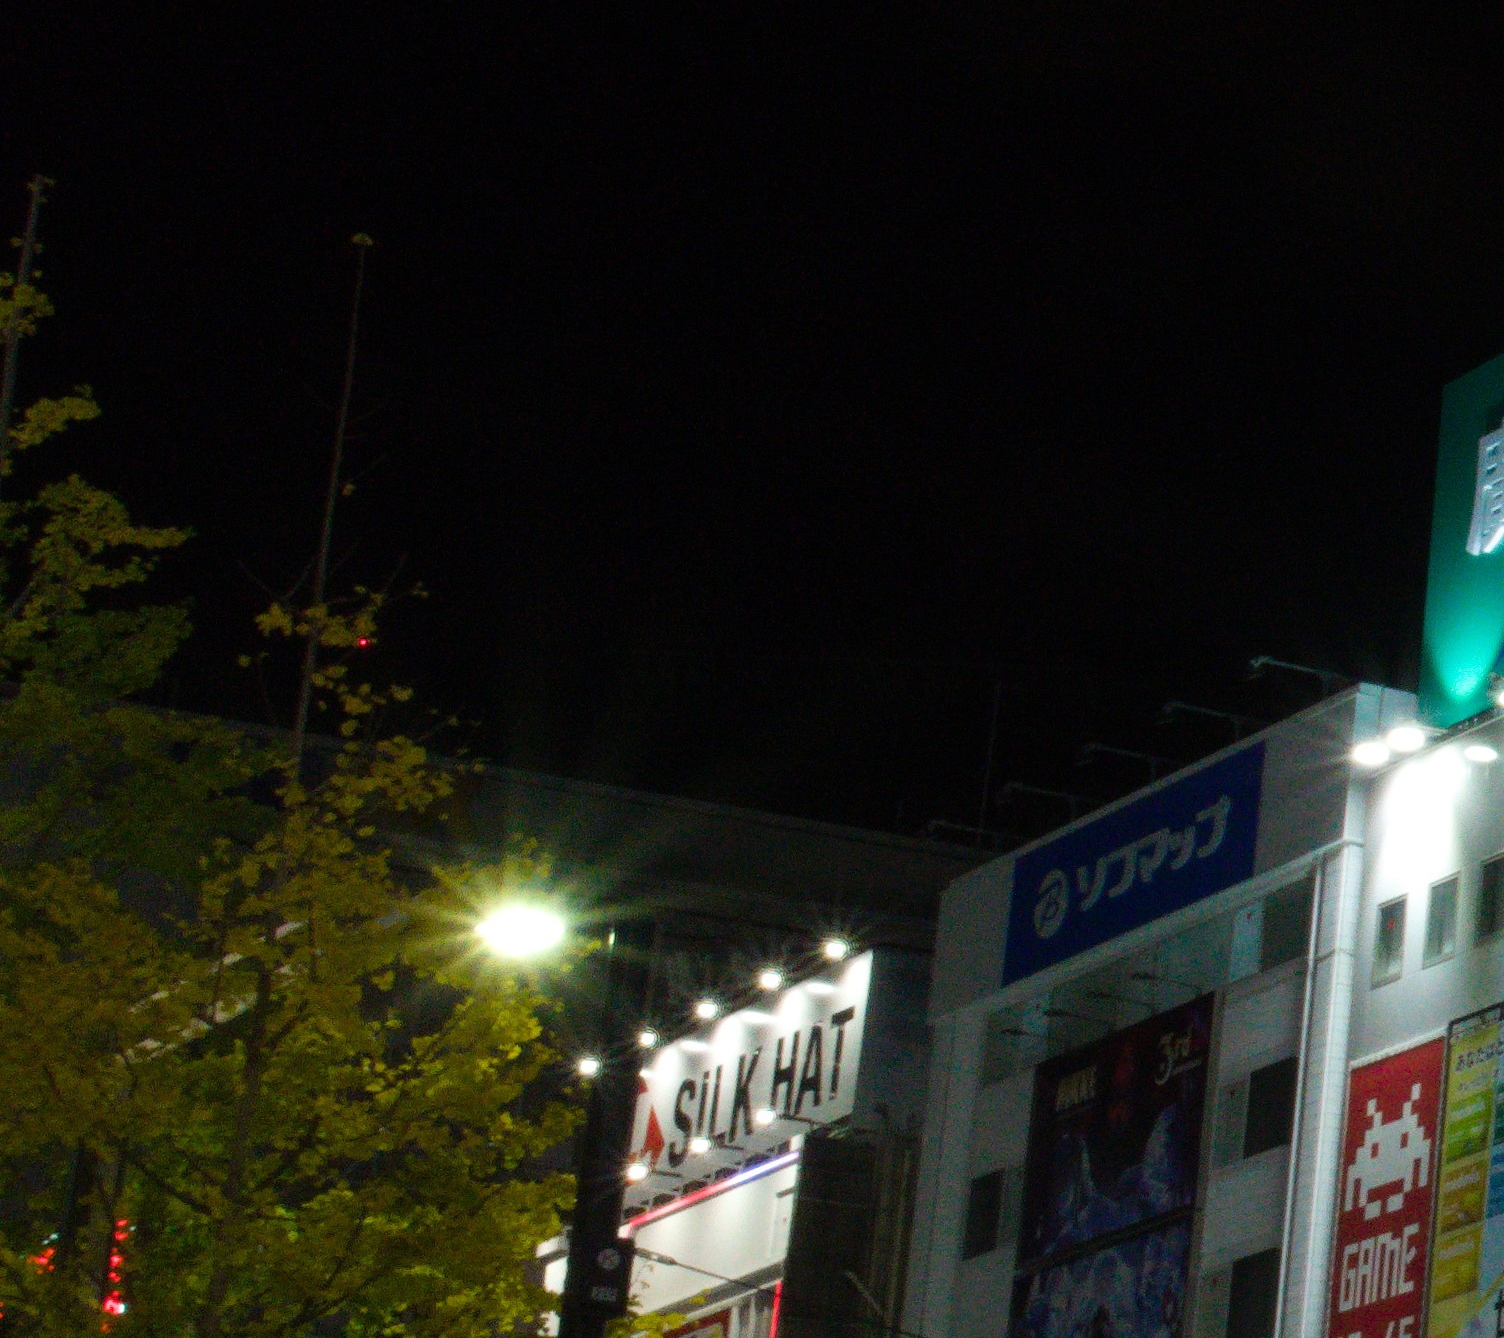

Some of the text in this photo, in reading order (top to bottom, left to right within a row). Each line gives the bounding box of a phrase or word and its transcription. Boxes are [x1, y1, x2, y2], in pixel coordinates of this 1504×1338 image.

[1072, 793, 1232, 920] ソフマップ
[670, 1006, 856, 1169] SILK HAT
[1338, 1224, 1420, 1315] GAME
